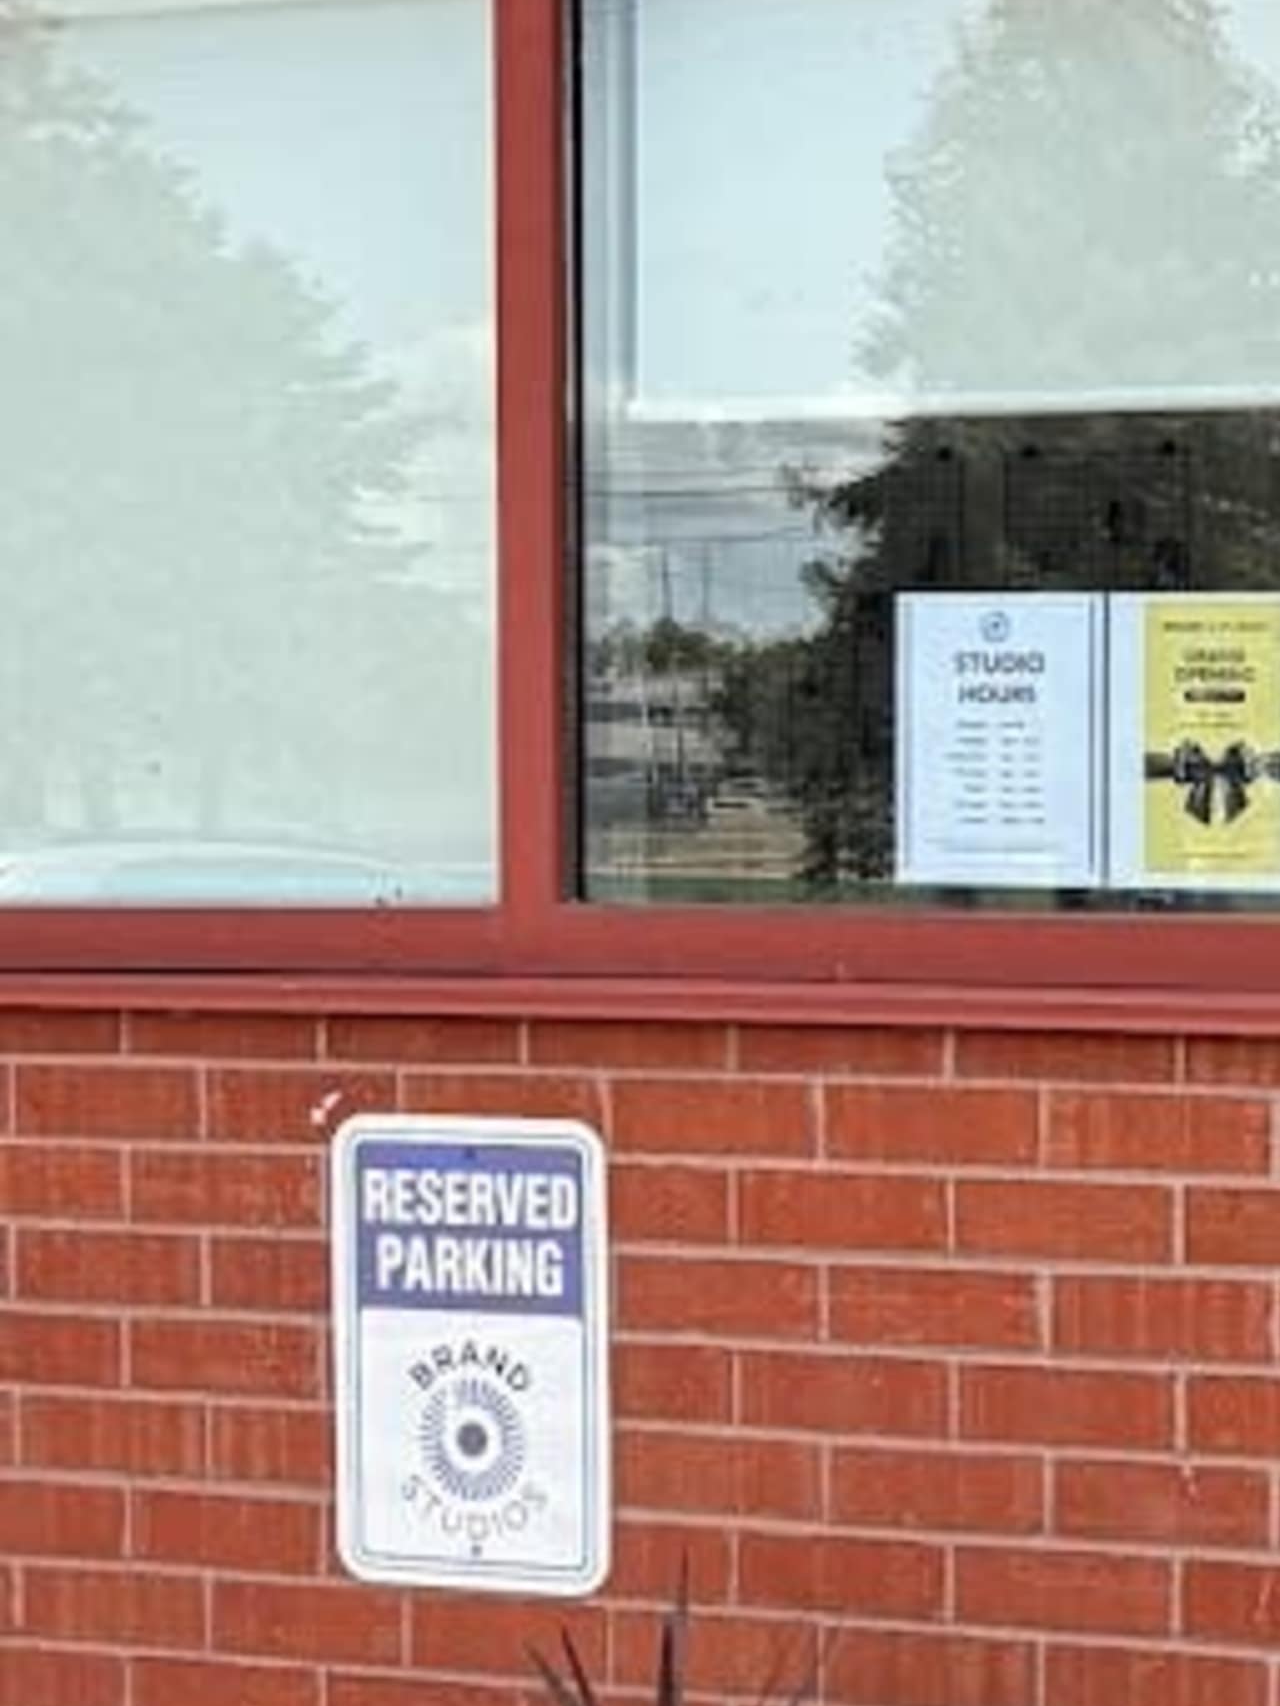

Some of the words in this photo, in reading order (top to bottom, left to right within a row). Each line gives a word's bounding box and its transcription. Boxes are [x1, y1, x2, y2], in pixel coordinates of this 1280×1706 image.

[953, 651, 1045, 675] STUDIO
[958, 684, 1037, 704] HOURS
[363, 1168, 577, 1230] RESERVED
[376, 1234, 564, 1297] PARKING
[407, 1339, 533, 1393] BRAND
[402, 1474, 549, 1542] STUDIOS
